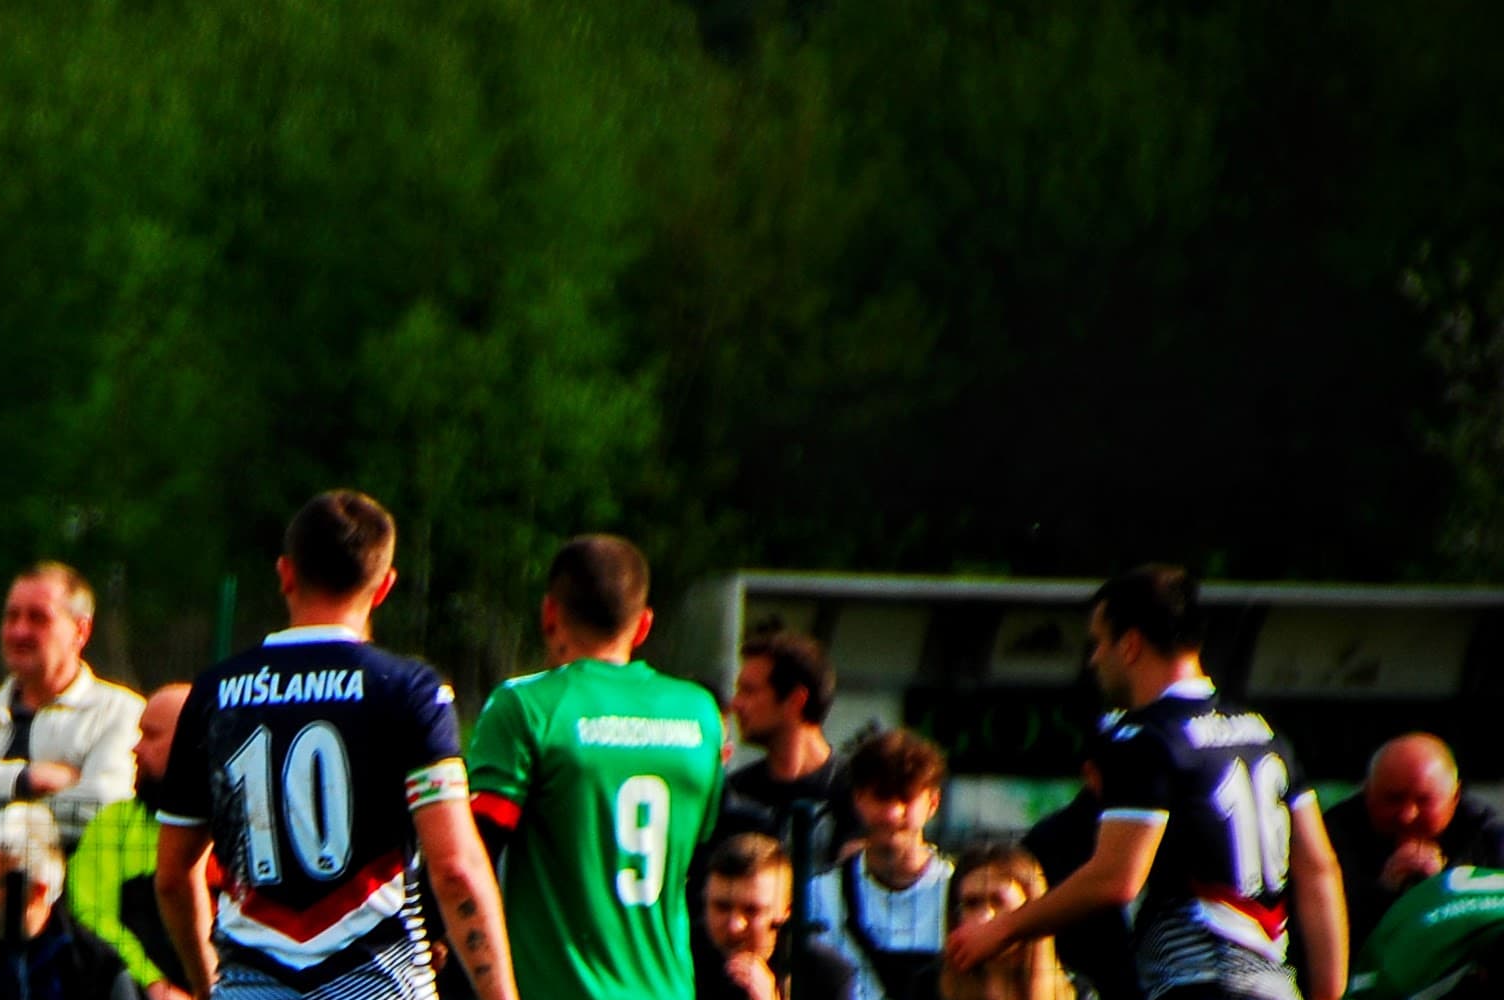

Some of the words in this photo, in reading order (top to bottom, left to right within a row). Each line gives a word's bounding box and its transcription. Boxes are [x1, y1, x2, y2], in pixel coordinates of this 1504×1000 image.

[217, 666, 364, 709] WIŚLANKA
[224, 719, 354, 886] 10
[615, 774, 671, 907] 9
